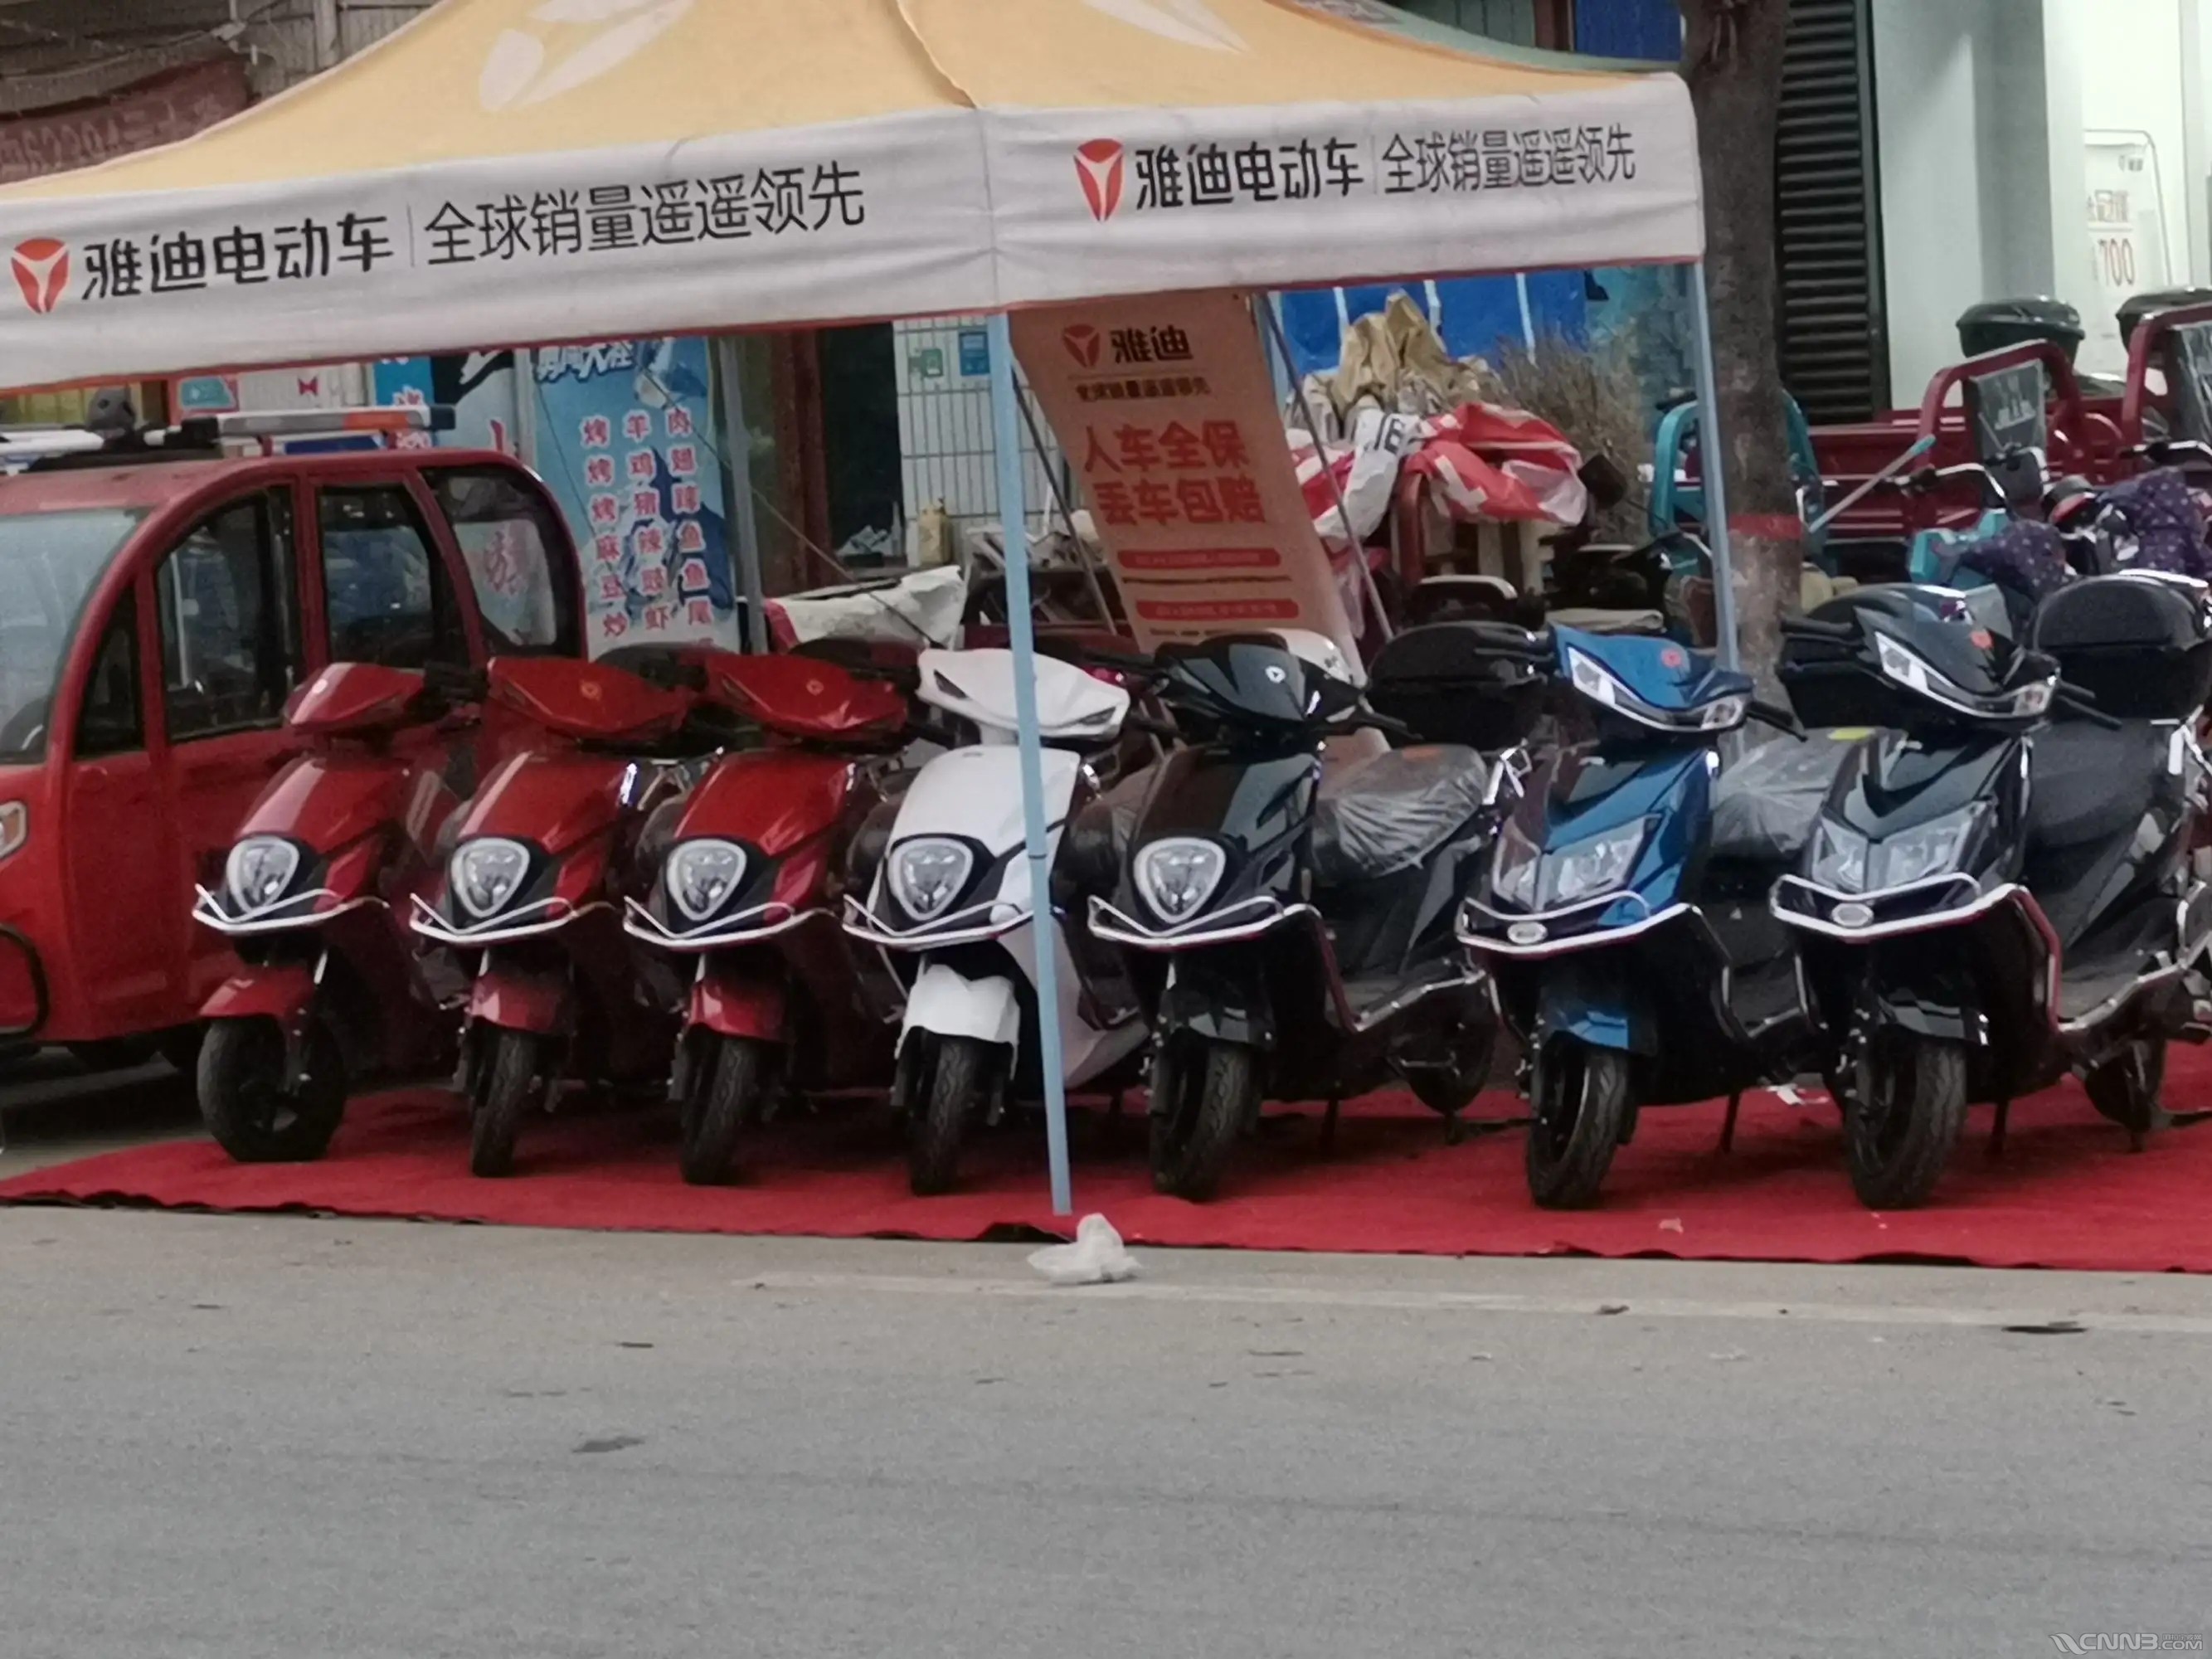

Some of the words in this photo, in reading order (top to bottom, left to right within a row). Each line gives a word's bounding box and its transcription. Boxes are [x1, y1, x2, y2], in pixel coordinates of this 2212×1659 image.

[1135, 137, 1364, 210] 雅迪电动车
[1381, 124, 1635, 194] 全球销量遥遥领先
[82, 212, 394, 300] 雅迪电动车
[425, 160, 865, 265] 全球销量遥遥领先
[1109, 324, 1194, 364] 雅迪
[1083, 420, 1250, 474] 人车全保
[1092, 474, 1267, 528] 丢车包赔
